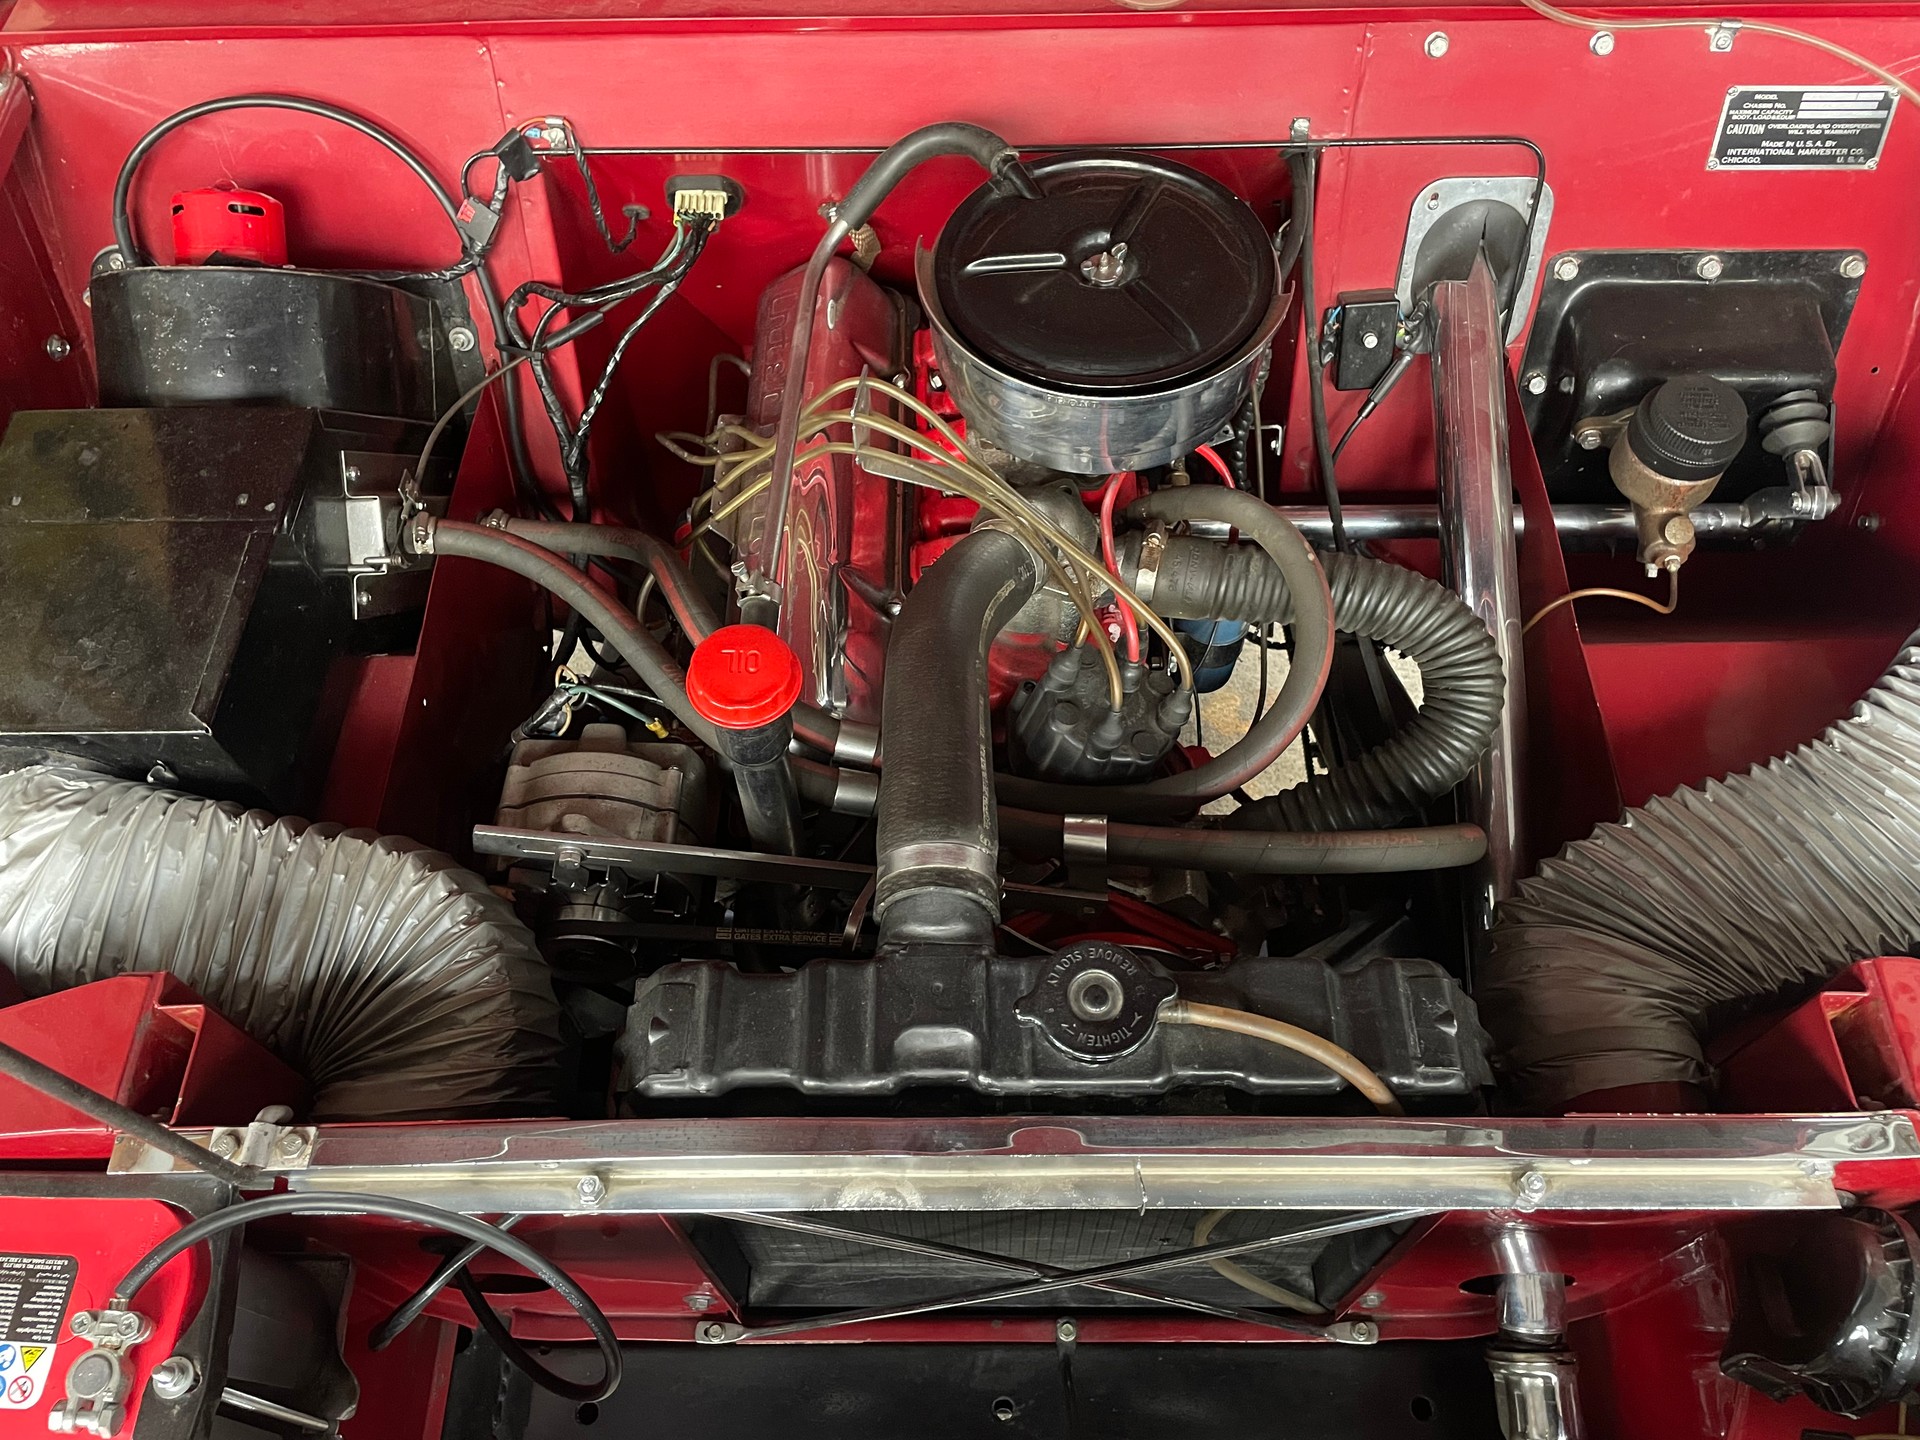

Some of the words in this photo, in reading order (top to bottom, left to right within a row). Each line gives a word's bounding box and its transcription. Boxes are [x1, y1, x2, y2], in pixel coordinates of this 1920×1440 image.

[1726, 124, 1766, 135] CAUTION
[1727, 148, 1795, 156] INTERNATIONAL
[733, 933, 761, 941] GATES
[763, 934, 791, 942] EXTRA
[792, 935, 827, 943] SERVICE
[1047, 950, 1083, 987] SLOWLY
[1088, 947, 1140, 976] REMOVE
[1077, 1026, 1133, 1047] TIGHTEN
